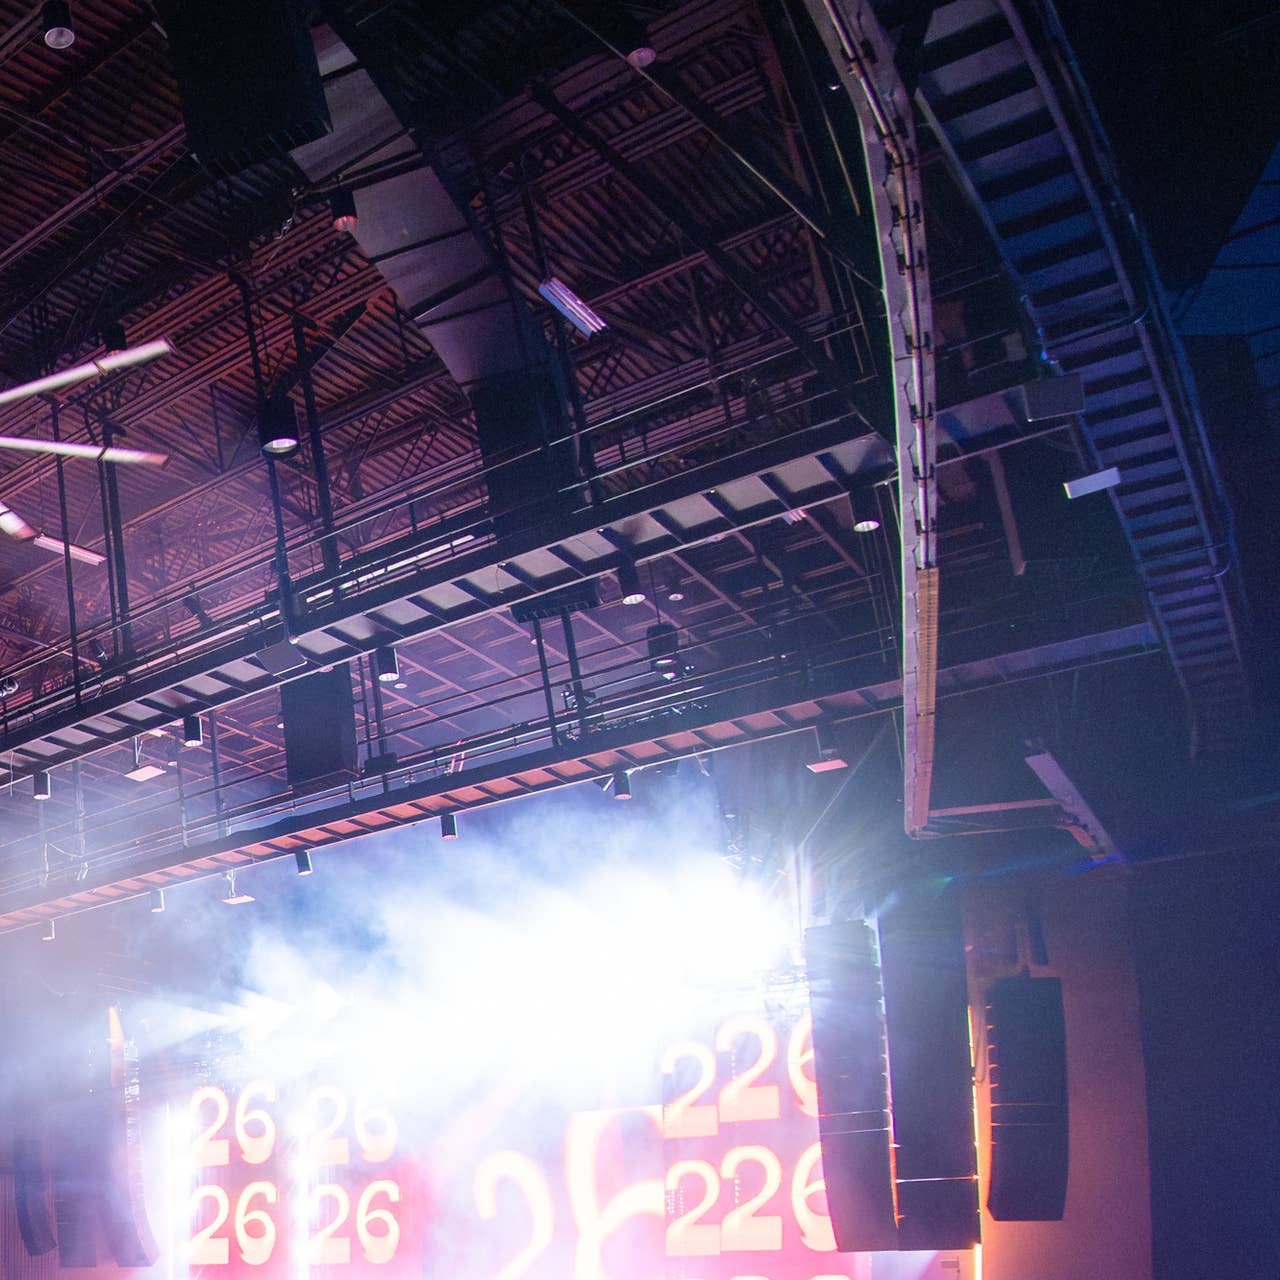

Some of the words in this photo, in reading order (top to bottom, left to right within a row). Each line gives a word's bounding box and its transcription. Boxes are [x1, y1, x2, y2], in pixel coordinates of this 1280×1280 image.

[190, 1080, 278, 1166] 26
[190, 1180, 278, 1266] 26
[308, 1180, 401, 1265] 26
